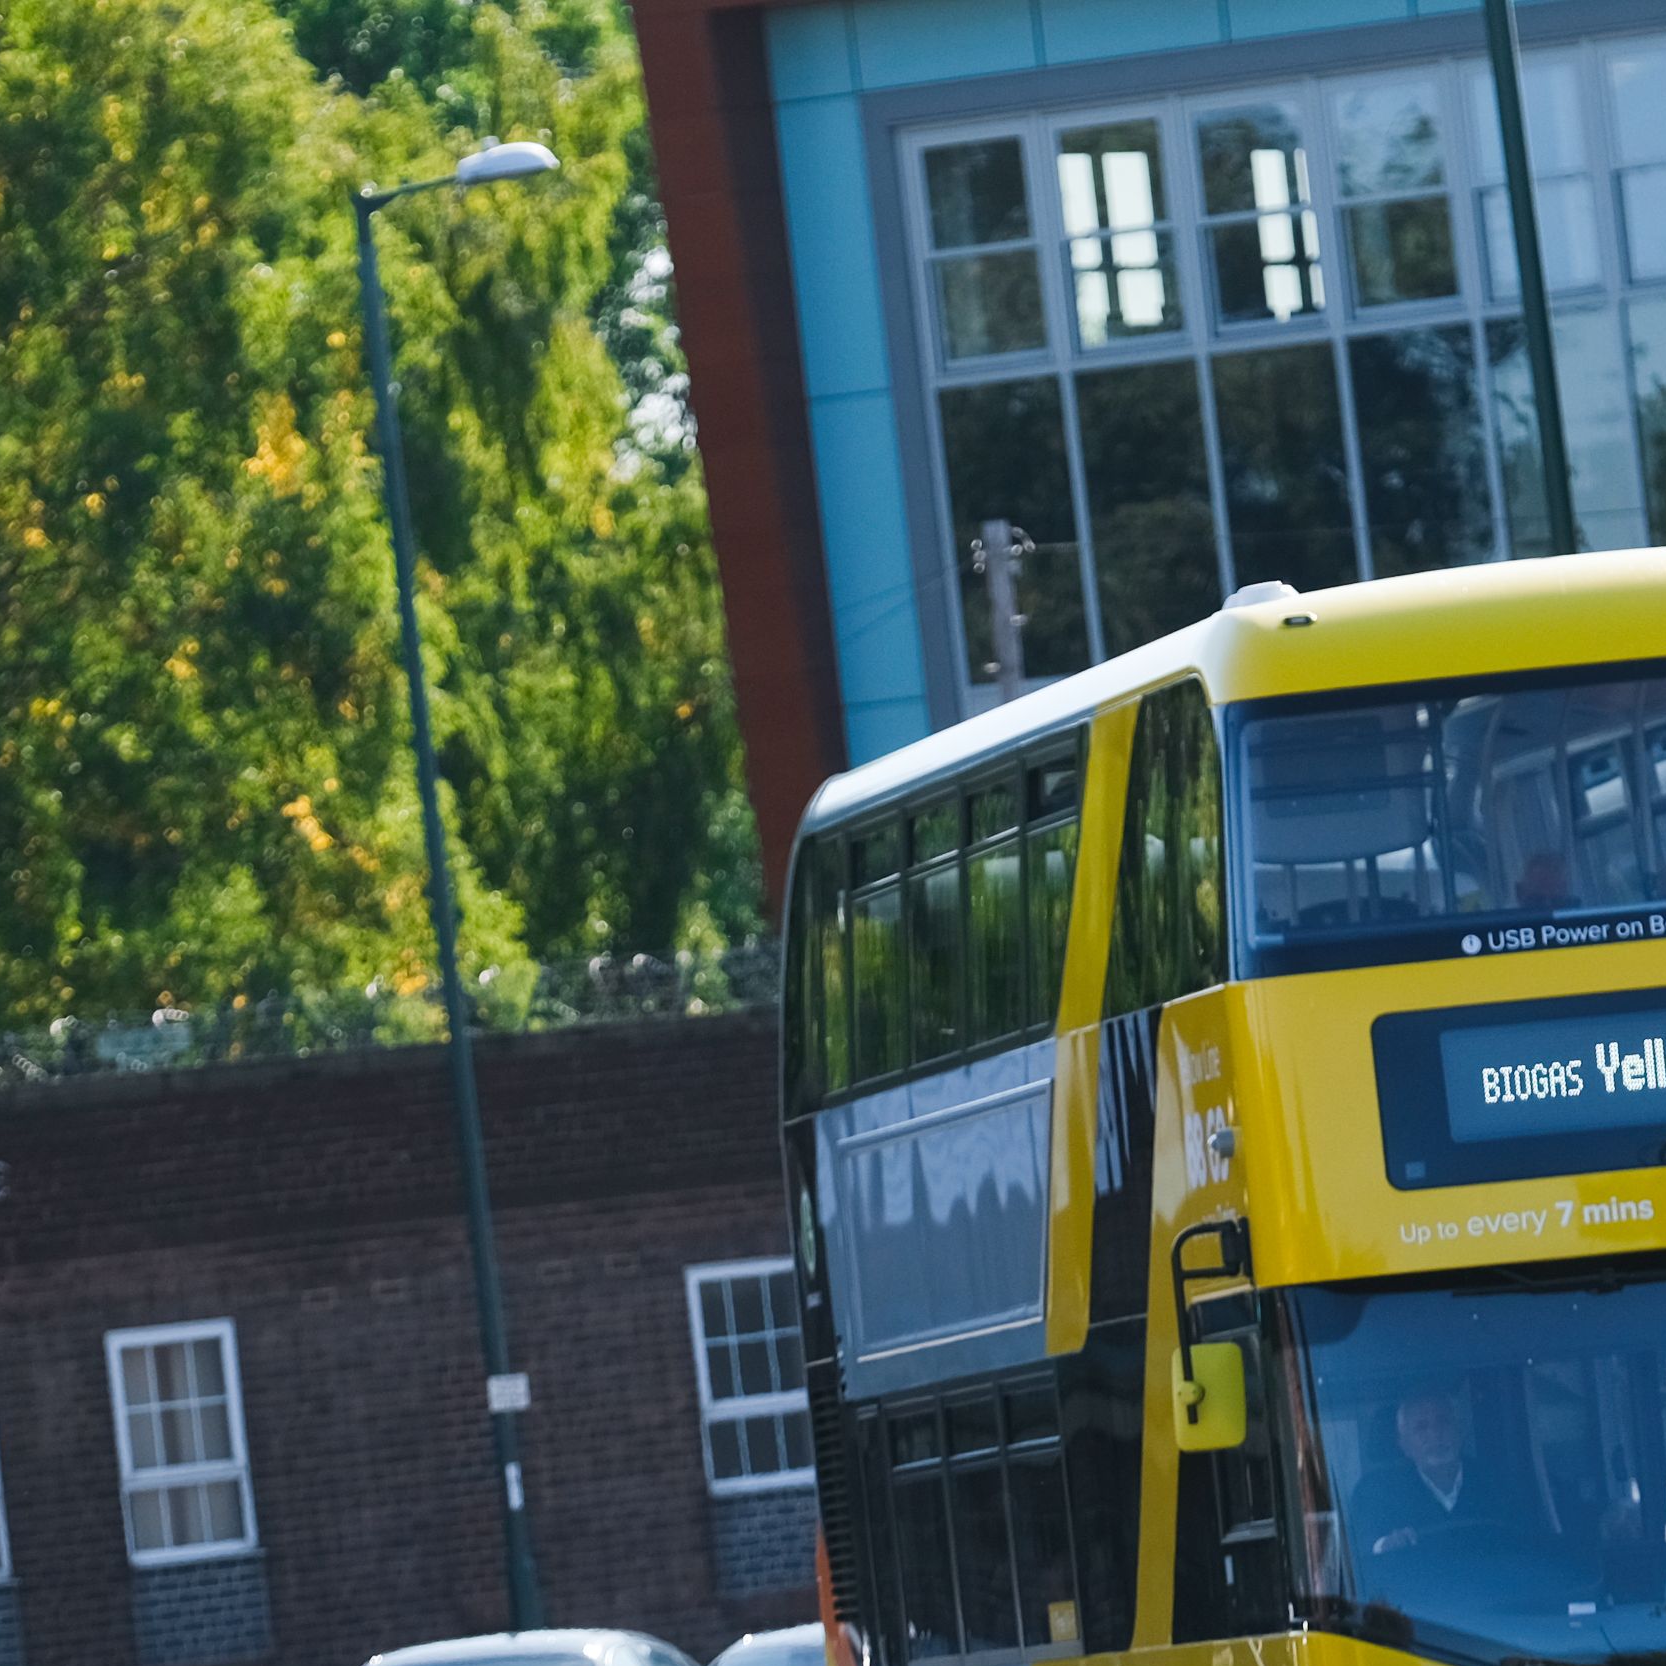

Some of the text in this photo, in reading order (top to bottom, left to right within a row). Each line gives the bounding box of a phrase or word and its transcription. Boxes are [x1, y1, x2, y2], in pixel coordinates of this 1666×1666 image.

[1487, 926, 1535, 952] USB
[1541, 923, 1611, 947] Power
[1617, 919, 1644, 939] on
[1481, 1059, 1585, 1104] BIOGAS
[1399, 1195, 1655, 1246] Up to every 7 mins
